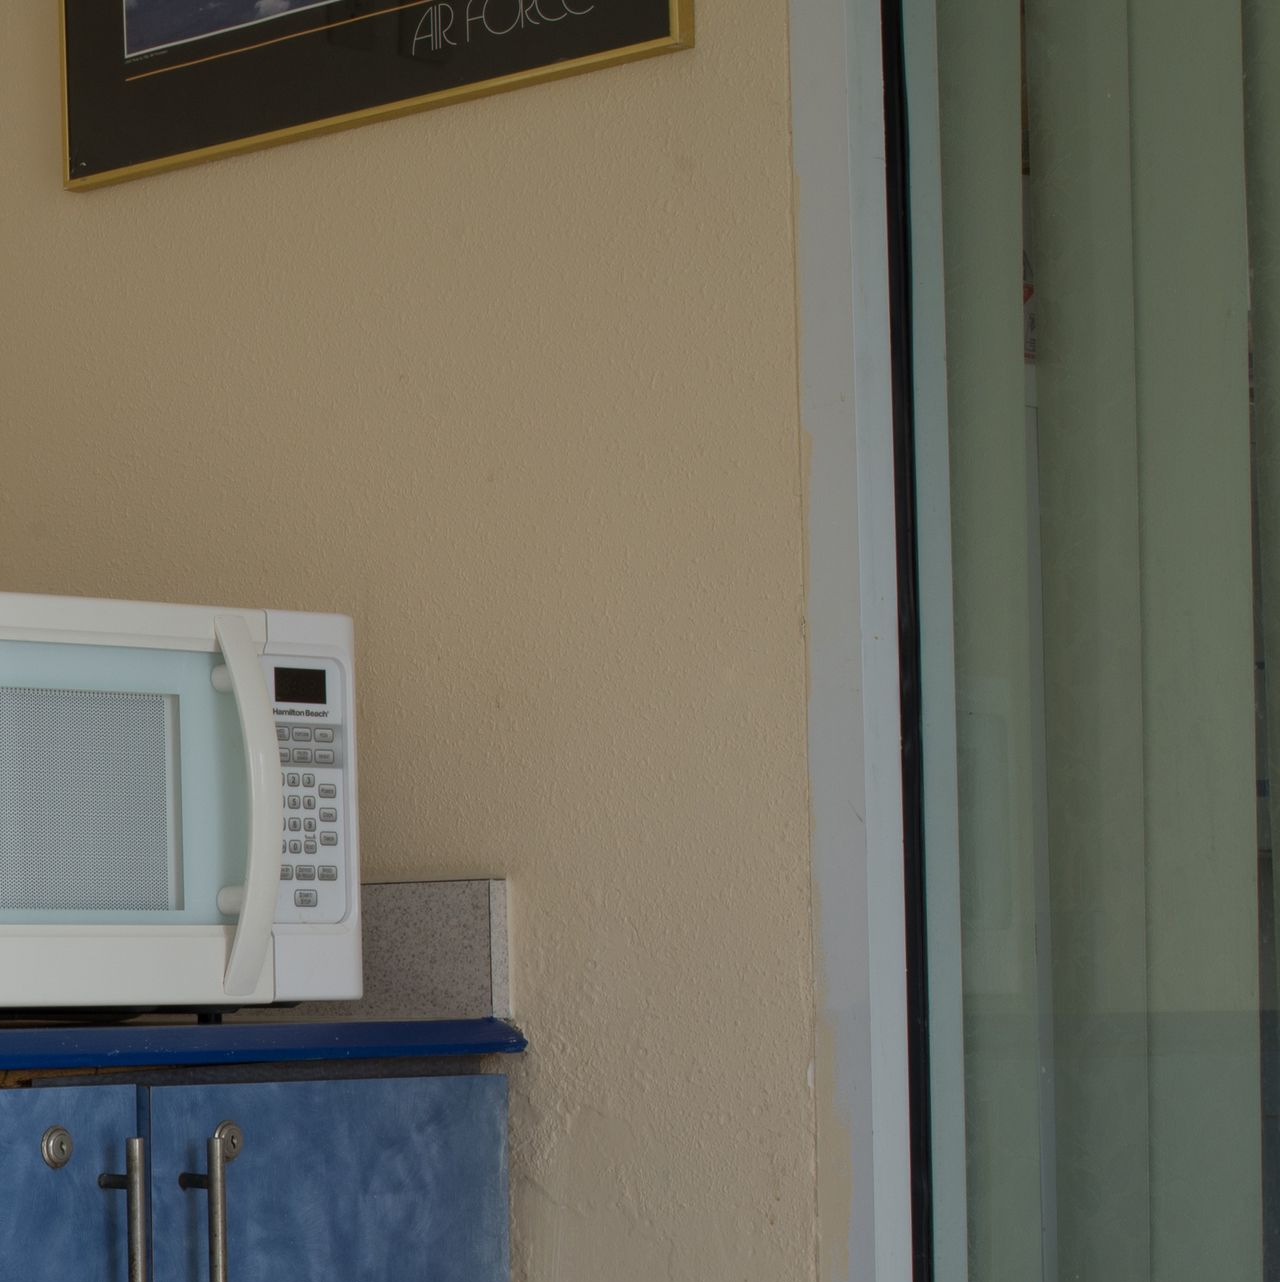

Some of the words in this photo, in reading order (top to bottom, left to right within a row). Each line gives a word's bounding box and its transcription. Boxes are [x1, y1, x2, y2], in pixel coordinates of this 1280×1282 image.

[412, 3, 457, 57] AIR
[273, 707, 305, 717] Hamilton
[305, 709, 328, 718] Beach
